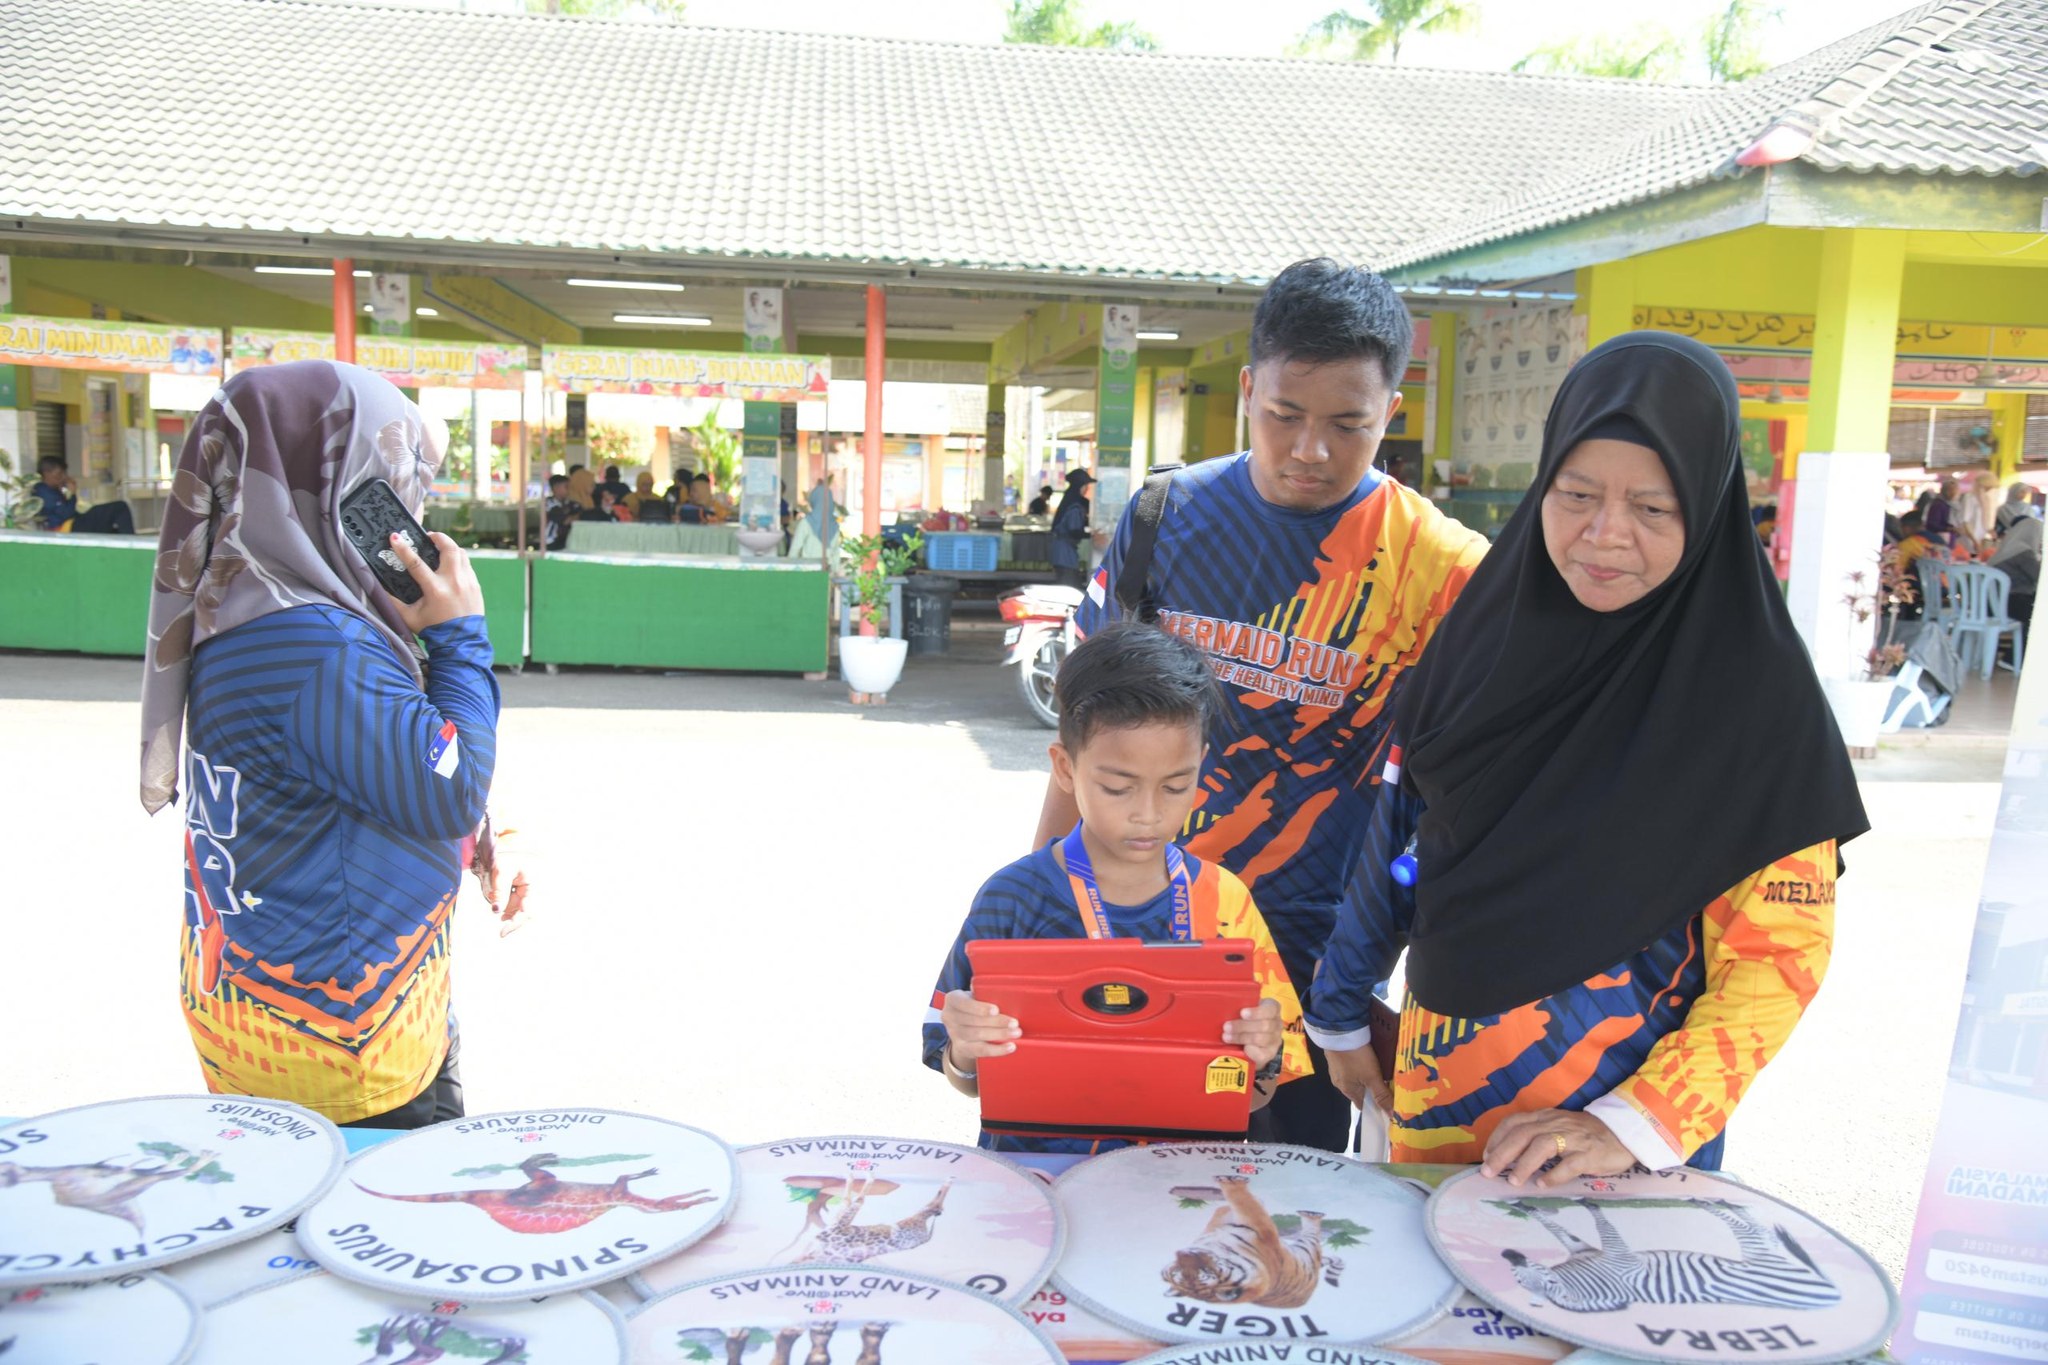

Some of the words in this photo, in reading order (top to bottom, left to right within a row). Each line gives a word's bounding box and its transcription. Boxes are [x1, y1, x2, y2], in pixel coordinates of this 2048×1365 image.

[46, 328, 171, 360] MINUMAN
[414, 347, 475, 373] MUIH
[554, 354, 628, 378] GERAI
[708, 359, 806, 386] BUAHAN
[1287, 635, 1359, 687] RUN
[1231, 665, 1303, 701] HEALTHY
[1300, 684, 1345, 709] MIND
[1173, 884, 1189, 925] RUN
[207, 1102, 317, 1141] DINOSAURS
[455, 1112, 606, 1135] DINOSAURS
[769, 1139, 887, 1158] ANIMALS
[896, 1143, 964, 1164] LAND
[1151, 1146, 1267, 1160] ANIMALS
[1275, 1150, 1345, 1172] LAND
[1627, 1161, 1687, 1183] LAN
[328, 1221, 649, 1285] SPINOSAURUS
[709, 1274, 849, 1300] ANIMALS
[859, 1276, 941, 1301] LAND
[1166, 1302, 1329, 1338] TIGER
[1452, 1306, 1504, 1325] say
[1635, 1322, 1819, 1353] ZEBRA
